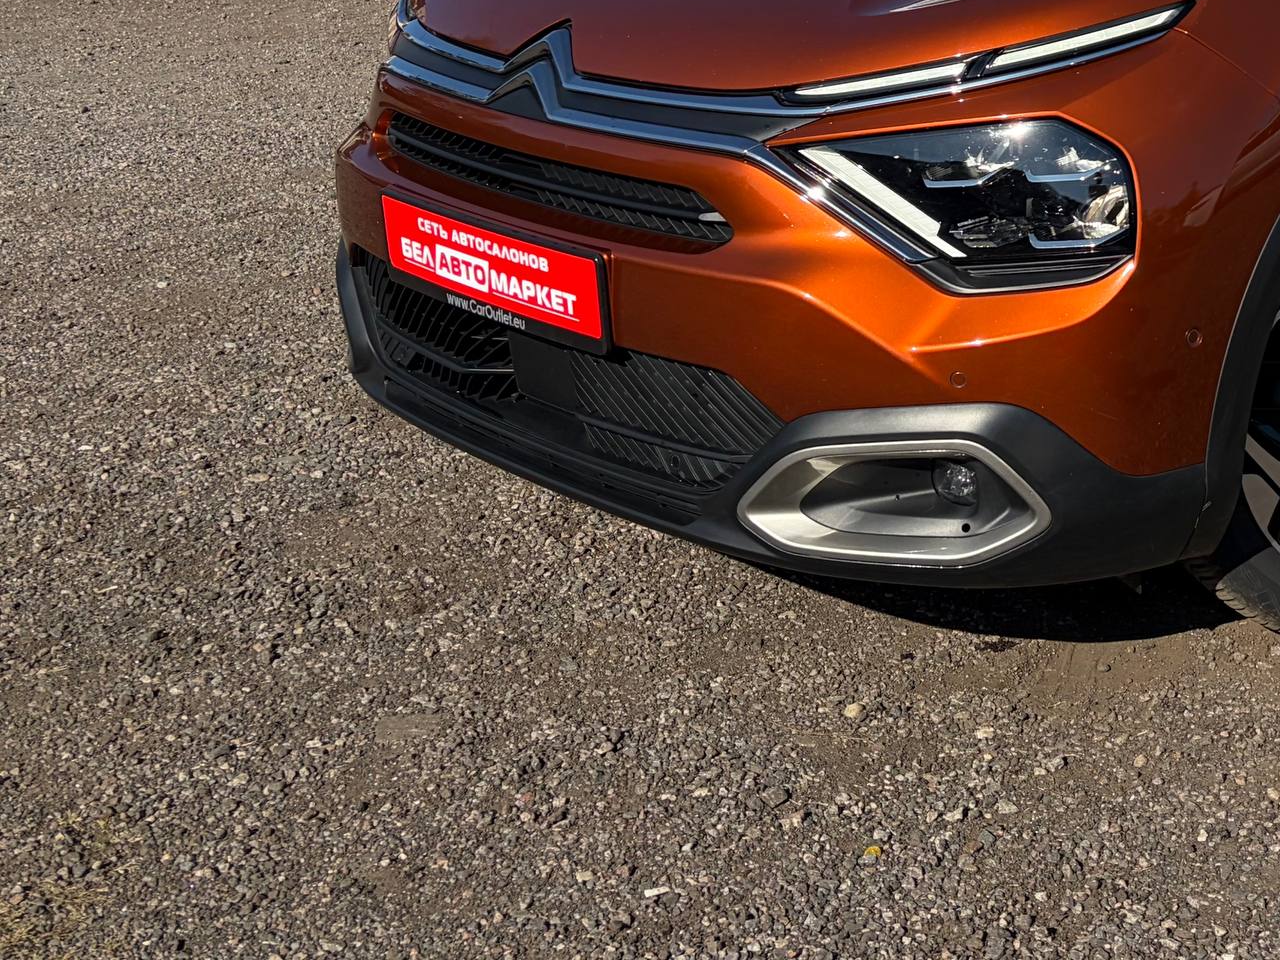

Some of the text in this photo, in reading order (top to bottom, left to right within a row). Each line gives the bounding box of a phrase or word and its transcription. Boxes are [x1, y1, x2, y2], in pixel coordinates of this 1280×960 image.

[417, 217, 549, 272] СЕТЬ АВТОСАЛОНОВ
[400, 236, 577, 315] БЕЛ АВТО МАРКЕТ
[446, 292, 526, 330] www.CarOutlet.eu
